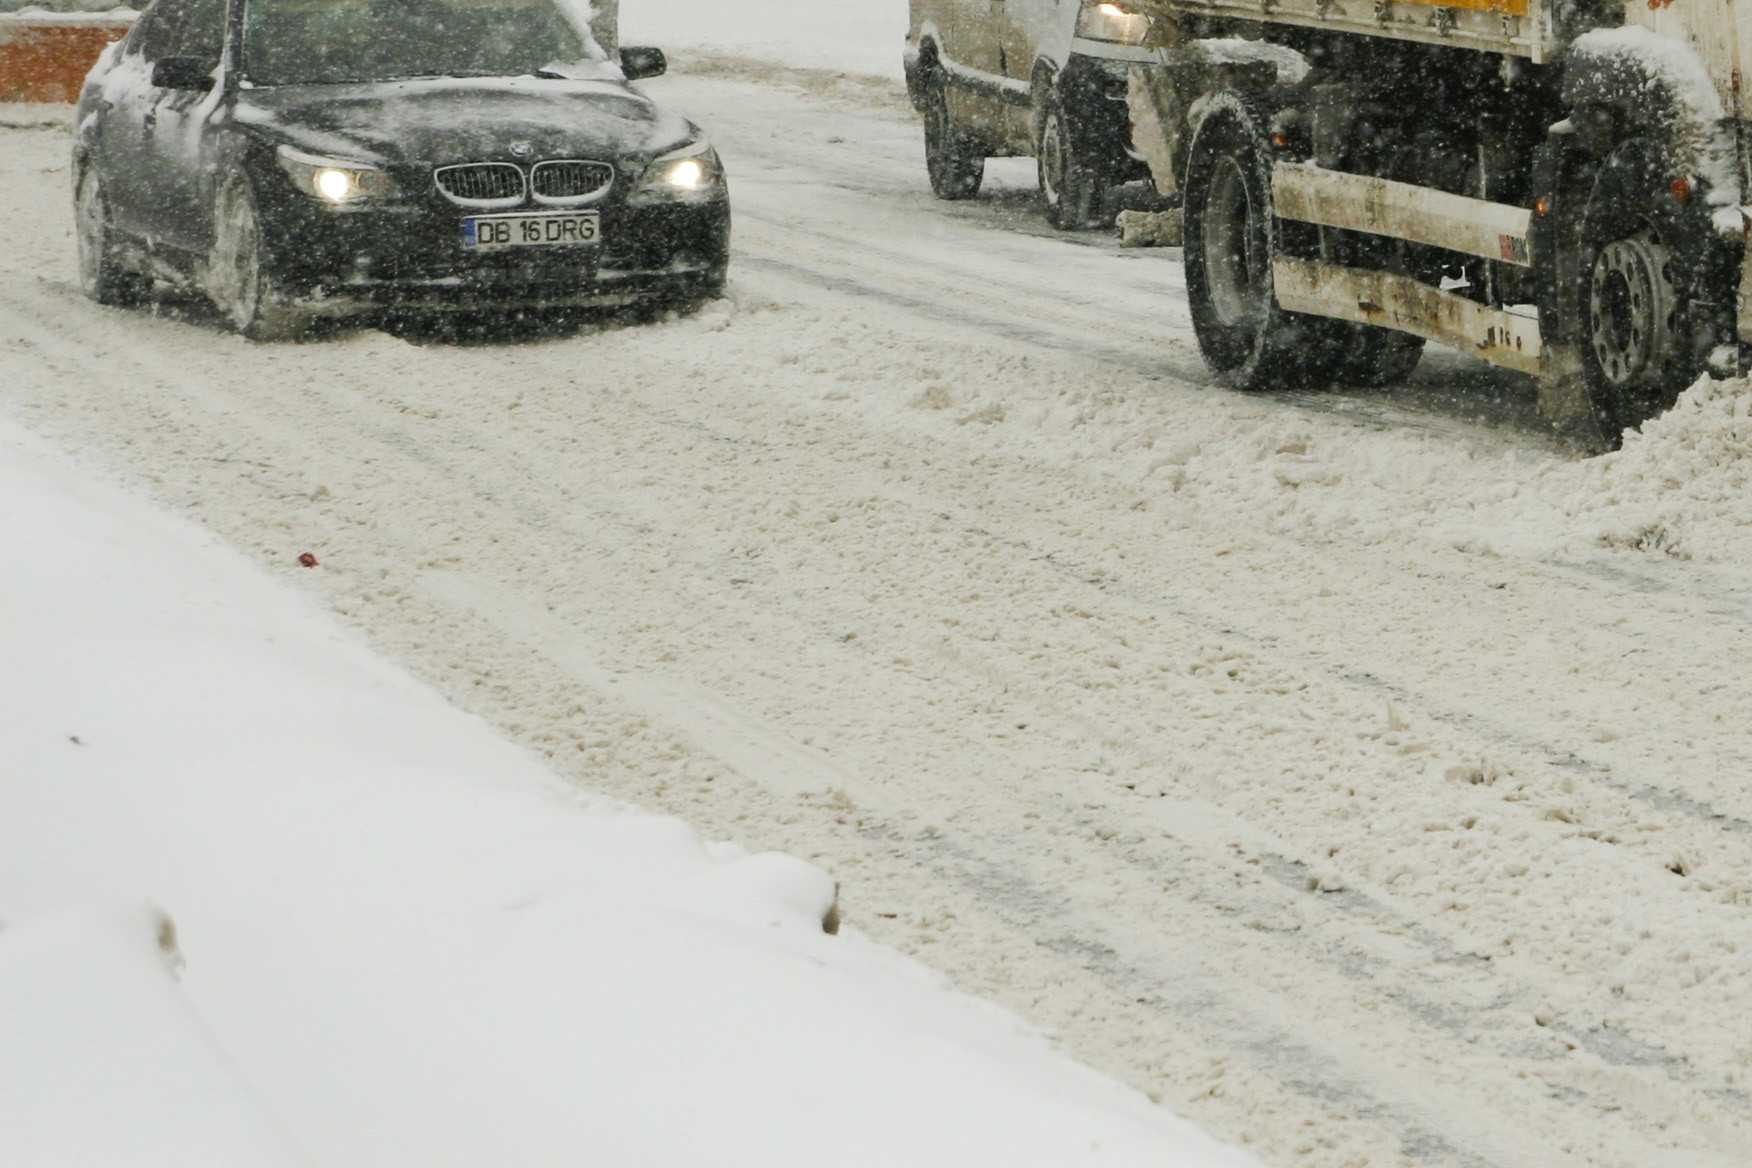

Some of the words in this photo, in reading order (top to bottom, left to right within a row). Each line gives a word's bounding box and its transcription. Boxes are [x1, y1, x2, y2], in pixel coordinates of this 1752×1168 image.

[478, 221, 511, 244] DB
[520, 220, 541, 242] 16
[545, 218, 595, 241] DRG
